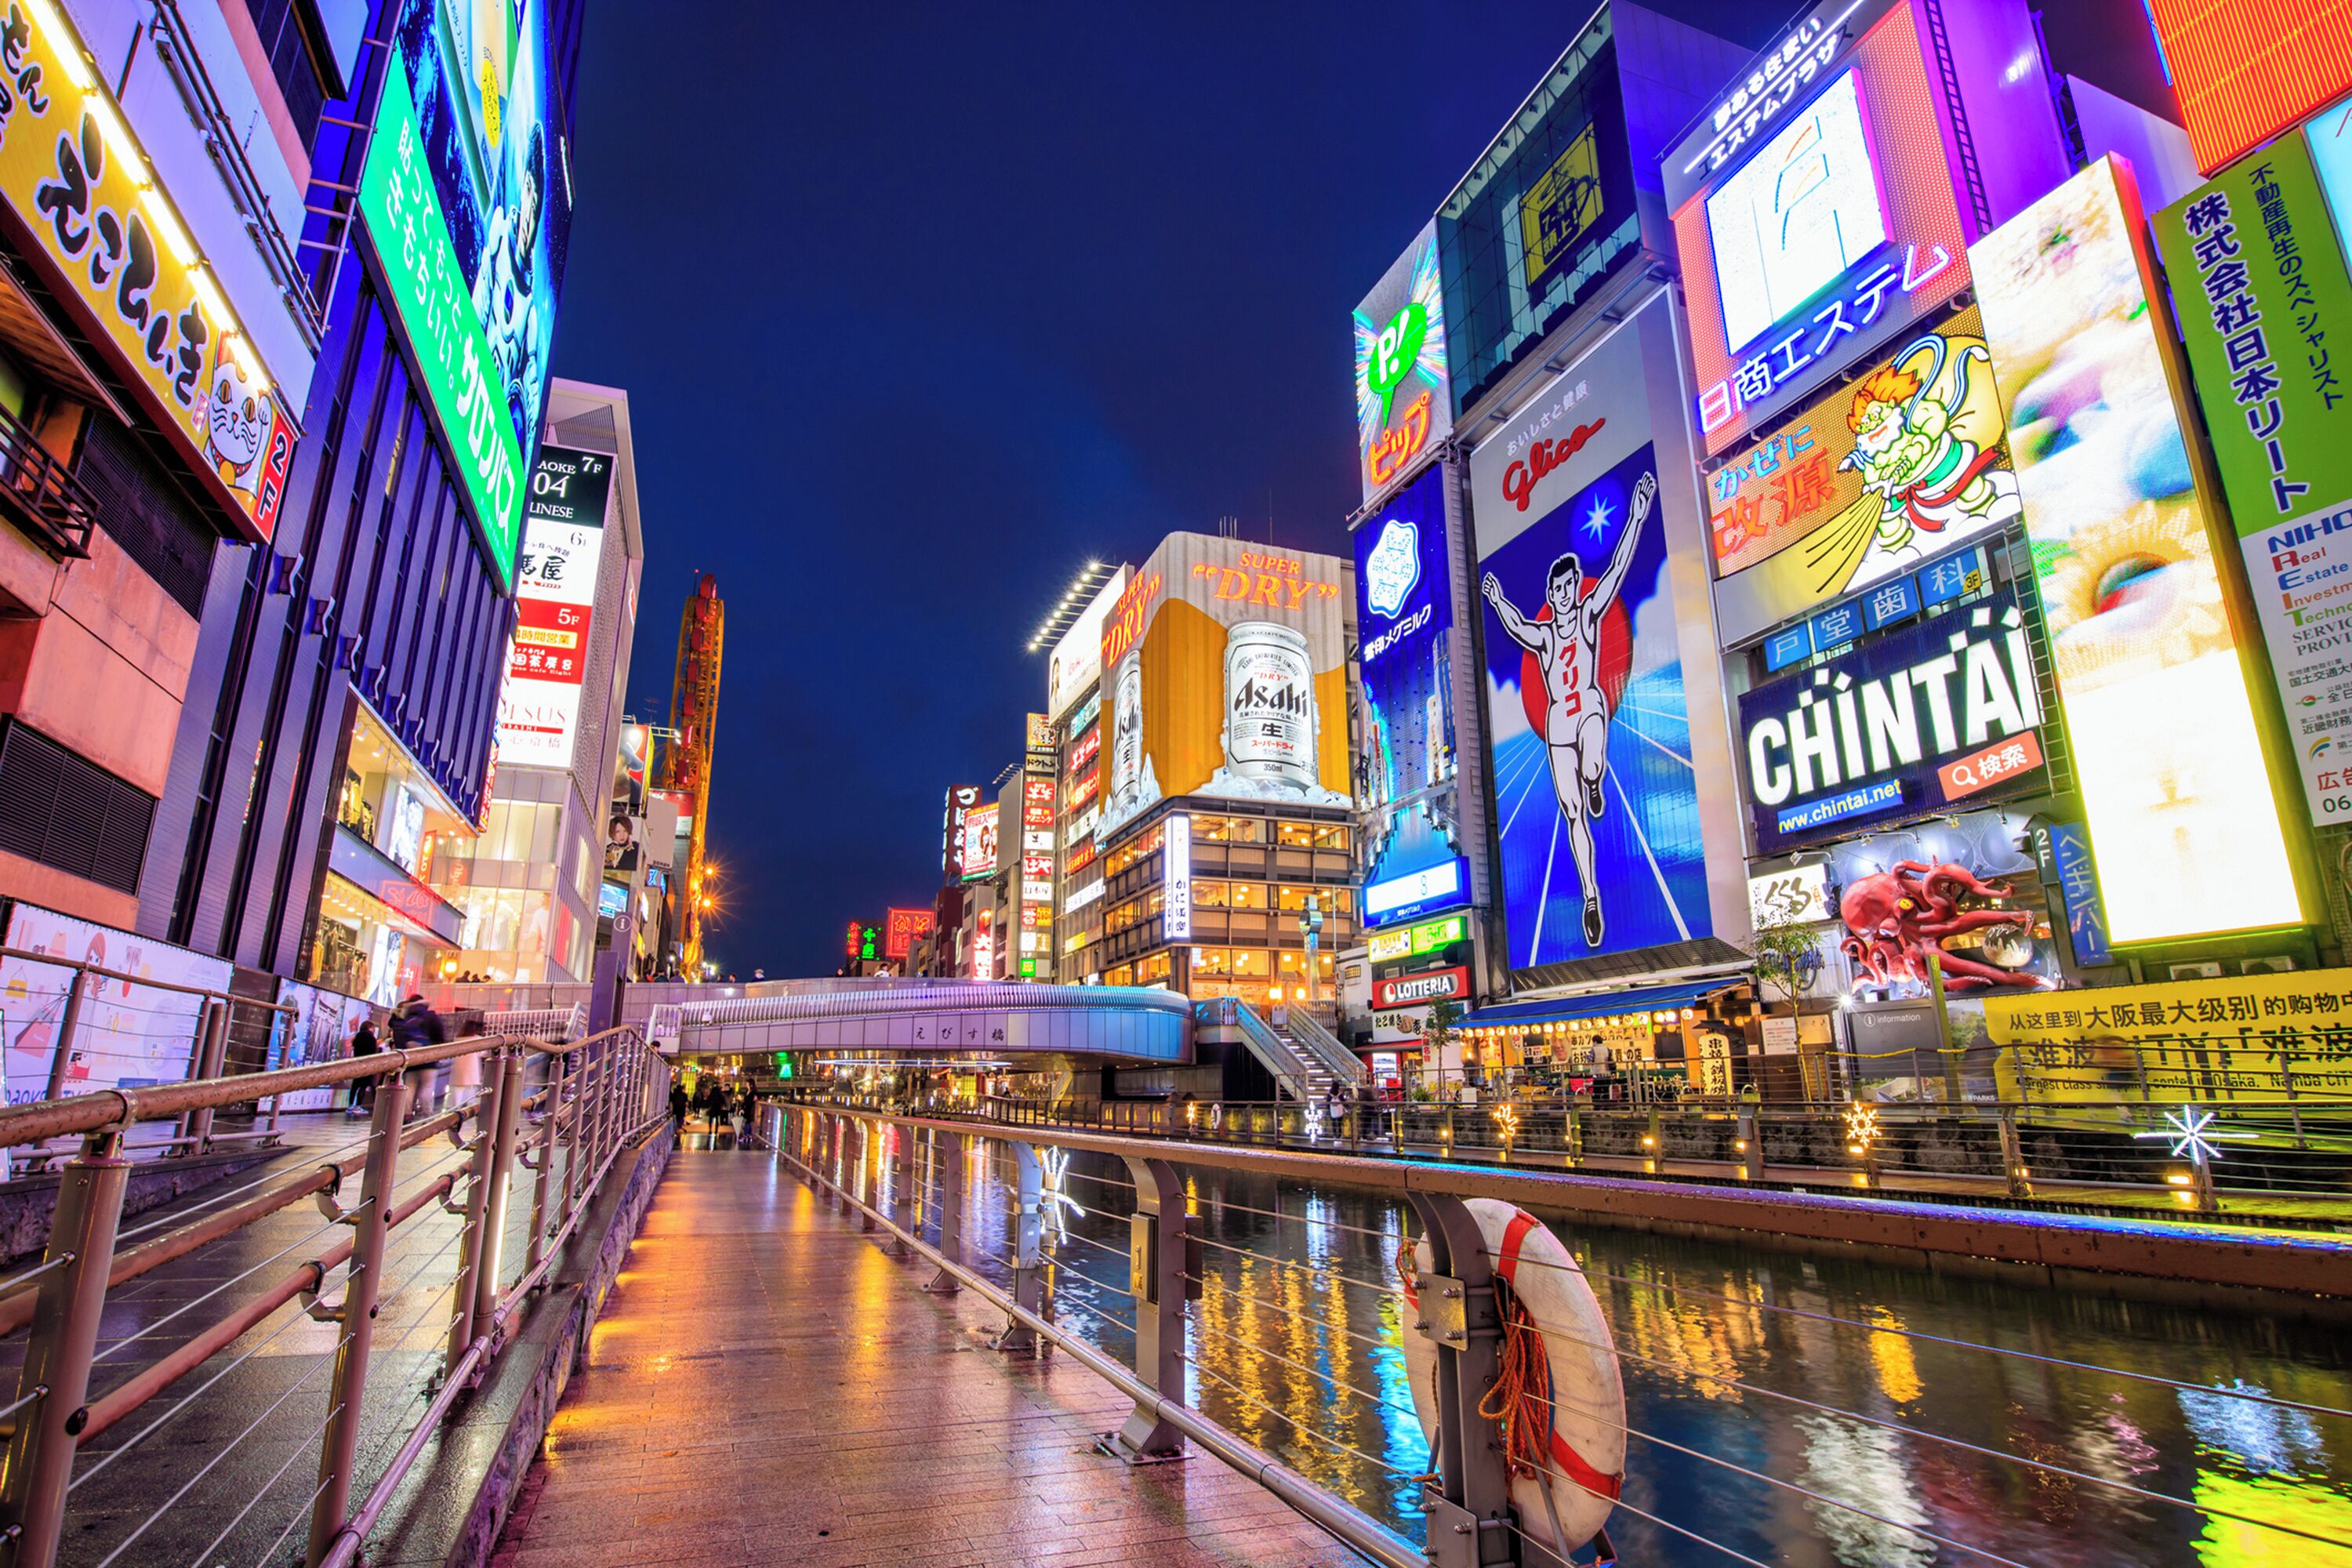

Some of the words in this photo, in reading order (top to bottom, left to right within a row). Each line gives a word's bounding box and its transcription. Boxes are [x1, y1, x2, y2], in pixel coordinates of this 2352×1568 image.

[387, 168, 455, 390] きもちいい。
[2248, 161, 2344, 411] 不動産再生のスペシャリスト
[1697, 243, 1954, 434] 日商エステム
[2184, 191, 2311, 514] 株式会社日本リート
[456, 330, 517, 549] サロンパス
[1369, 390, 1431, 485] ピップ
[1506, 379, 1590, 458] おいしさと健康
[259, 433, 288, 519] 2F
[582, 456, 602, 473] 7F
[1501, 416, 1606, 513] Glico
[1714, 423, 1813, 503] かぜに
[1709, 447, 1835, 560] 改源
[1239, 552, 1301, 575] SUPER
[2272, 547, 2326, 572] Real
[2278, 563, 2349, 590] Estate
[1116, 571, 1144, 617] SUPER
[1964, 573, 1980, 590] 3F
[557, 608, 580, 626] 5F
[1363, 603, 1432, 662] 雪印メグミルク
[1234, 677, 1308, 718] Asahi
[1558, 636, 1582, 718] グリコ
[1251, 739, 1294, 751] スーパードライ
[1261, 722, 1283, 738] 生
[1976, 744, 2028, 780] 検索
[2035, 828, 2051, 868] 2F
[1396, 976, 1452, 1000] LOTTERIA
[915, 1027, 1004, 1041] えびす橋
[1877, 1013, 1921, 1024] information
